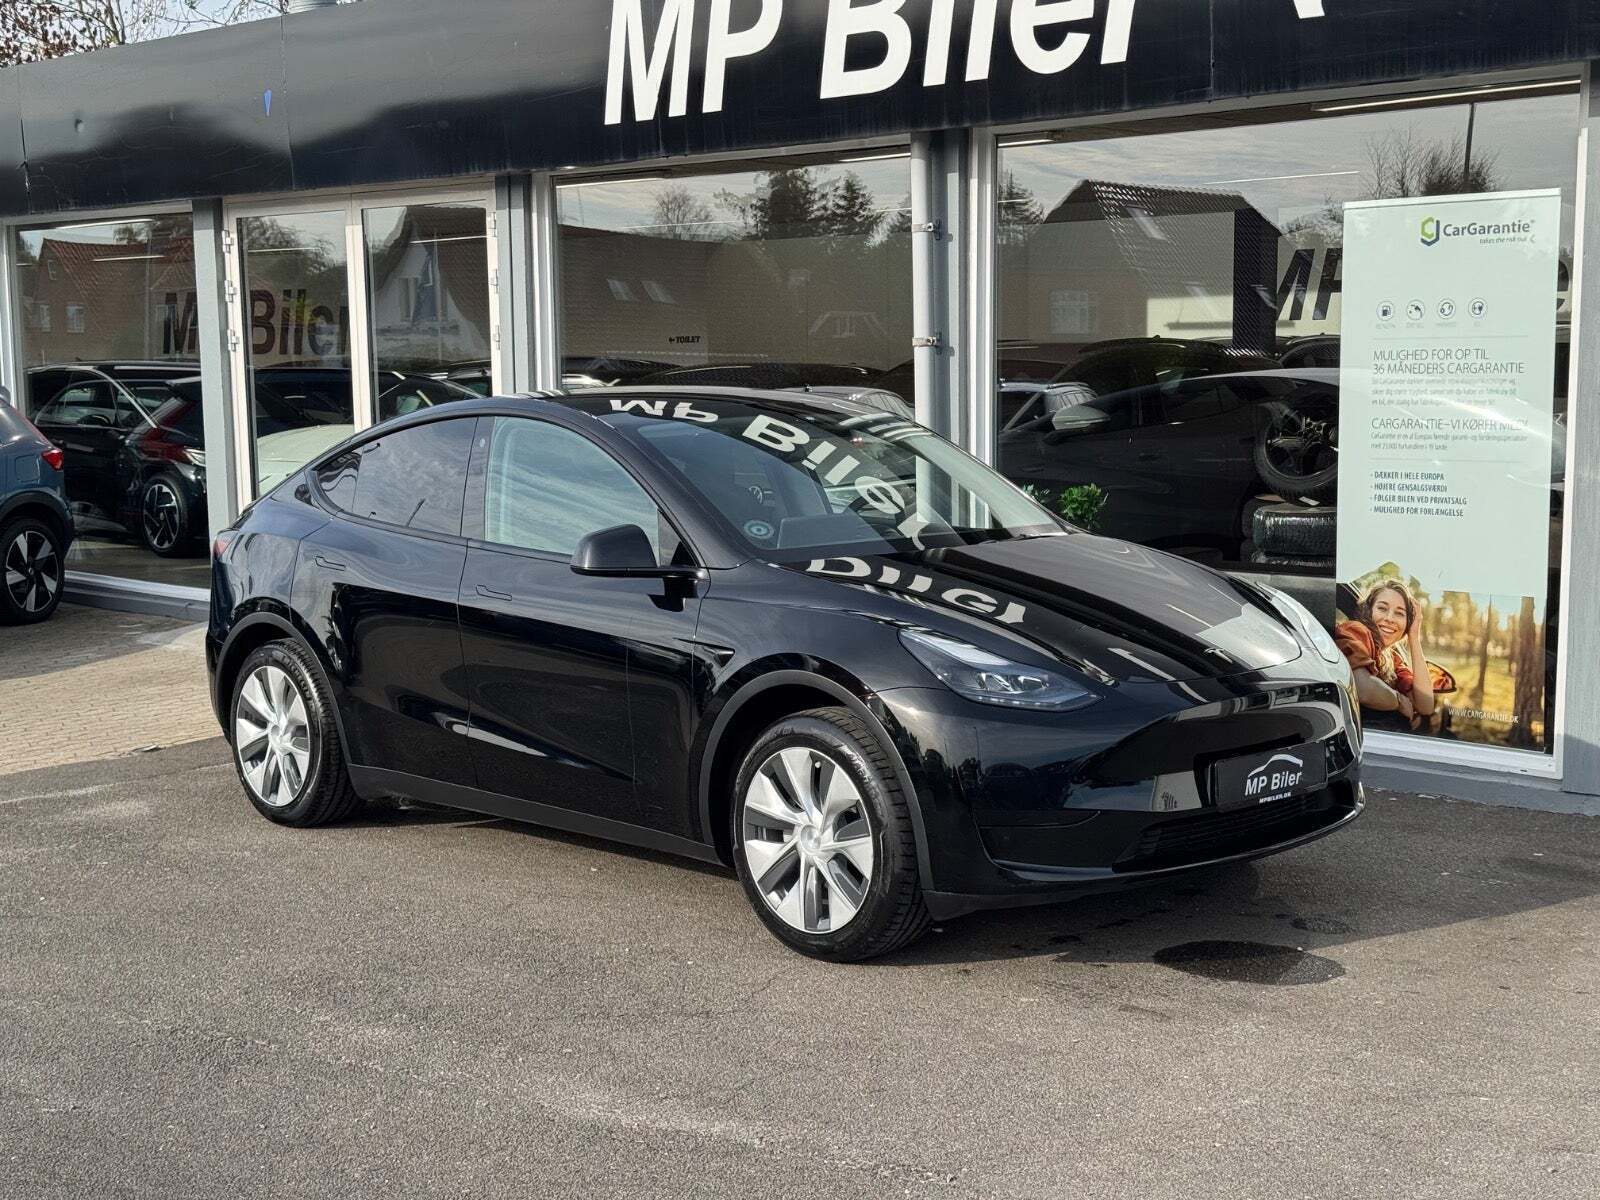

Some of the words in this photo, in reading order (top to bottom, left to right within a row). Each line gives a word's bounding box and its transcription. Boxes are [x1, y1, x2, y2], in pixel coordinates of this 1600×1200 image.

[603, 0, 783, 126] MP
[1443, 220, 1531, 237] CarGarantie
[1373, 349, 1429, 361] MULIGHED
[1431, 349, 1452, 360] FOR
[1454, 349, 1471, 360] OP
[1475, 348, 1489, 360] TIL
[1373, 363, 1385, 375] 36
[1387, 361, 1445, 375] MÅNEDERS
[1447, 362, 1525, 374] CARGARANTIE
[1420, 472, 1445, 480] EUROPA
[1244, 775, 1268, 796] MP
[1270, 770, 1303, 791] Biler
